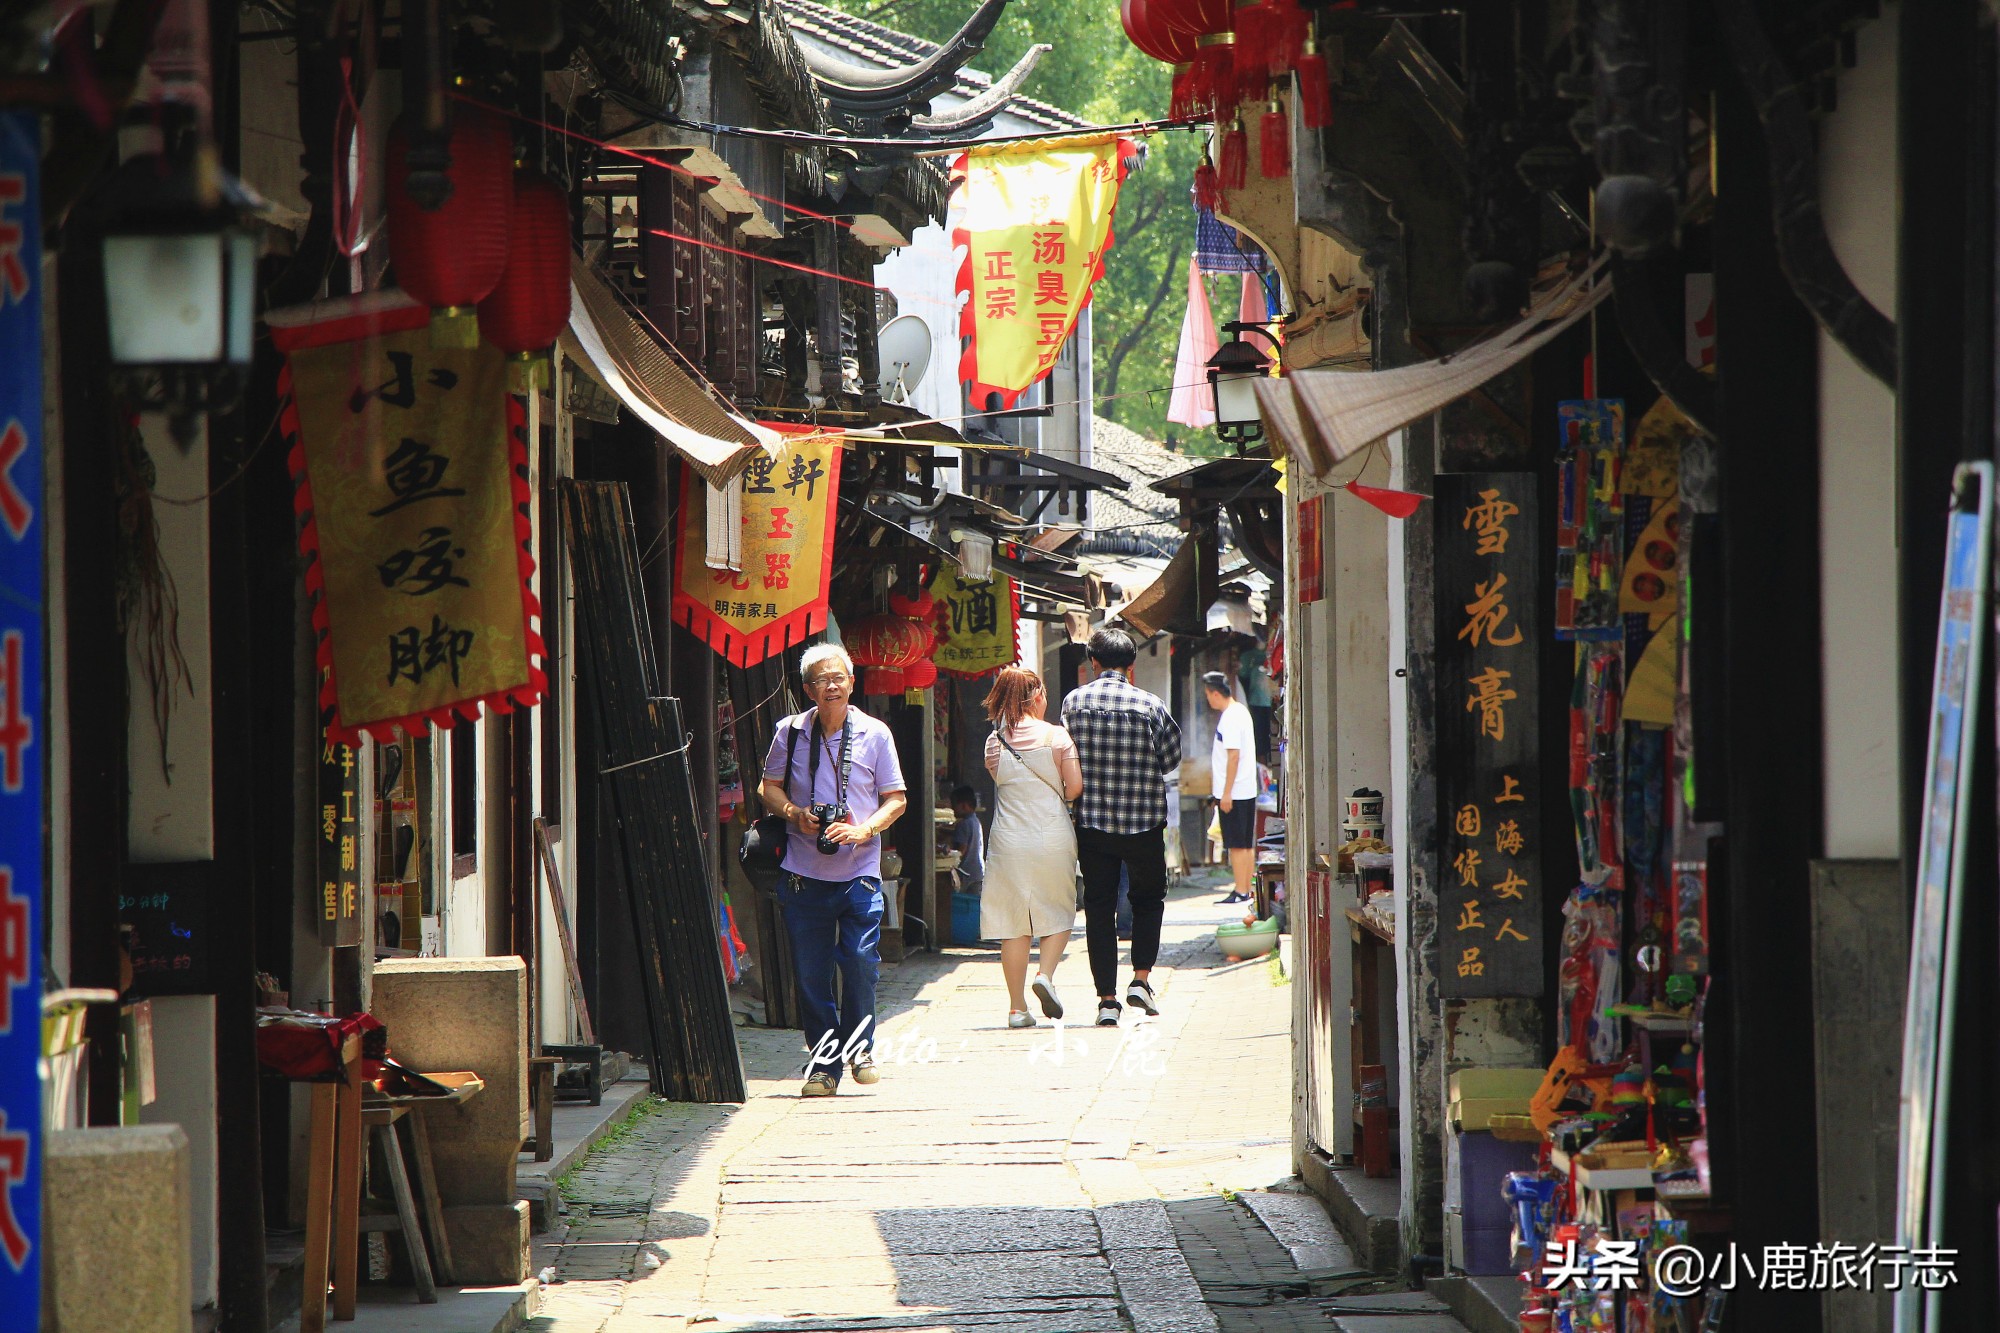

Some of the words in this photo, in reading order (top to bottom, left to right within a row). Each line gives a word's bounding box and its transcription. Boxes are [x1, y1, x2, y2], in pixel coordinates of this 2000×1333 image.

[984, 251, 1017, 319] 正宗
[350, 351, 474, 687] 小鱼咬脚
[714, 599, 778, 618] 明清家具
[947, 577, 997, 636] 酒
[1458, 489, 1523, 741] 雪花膏
[341, 743, 355, 918] 手工制作
[1454, 804, 1486, 977] 国货正品
[1492, 775, 1529, 943] 上海女人
